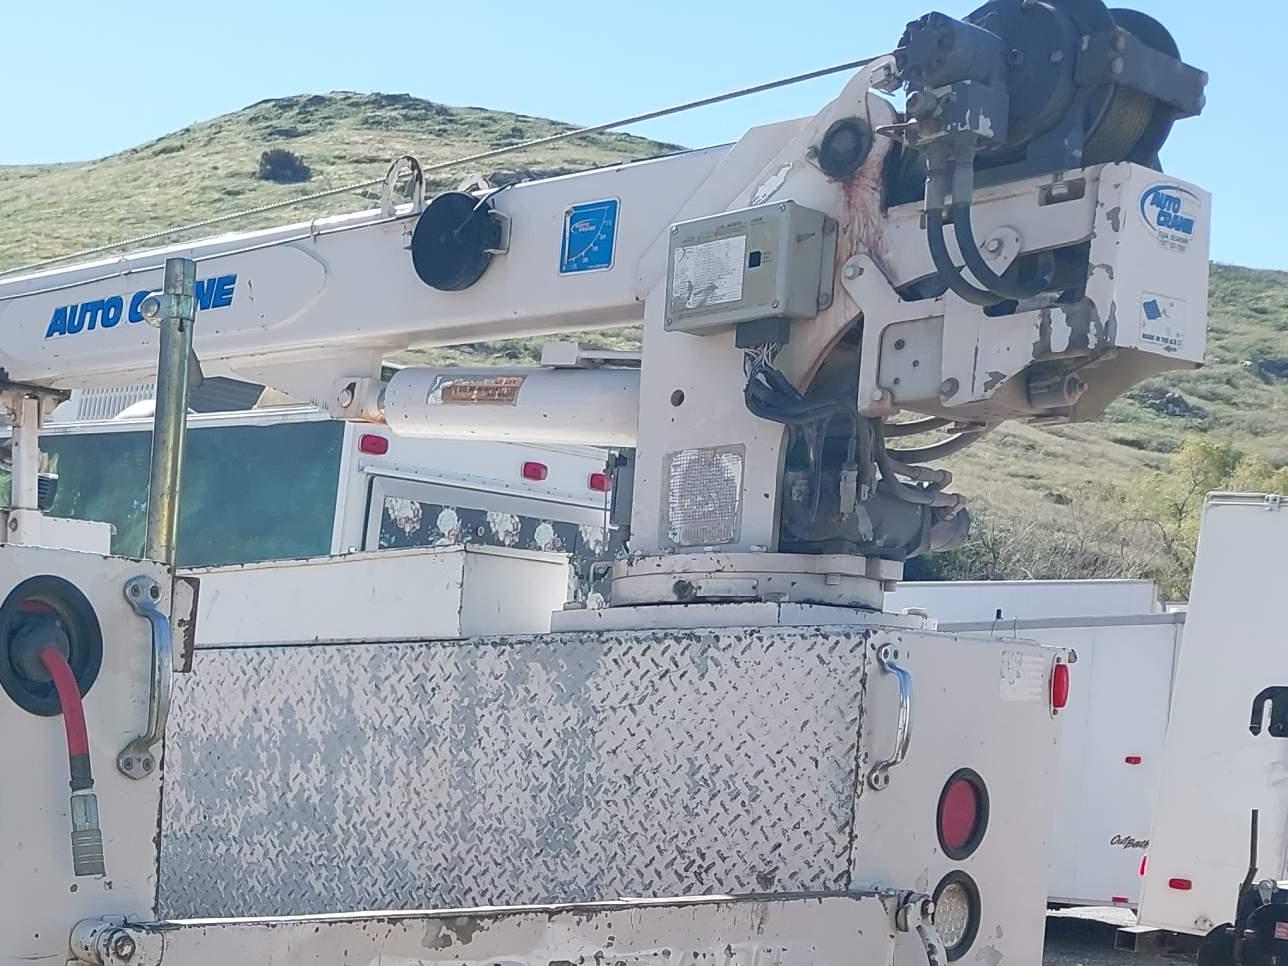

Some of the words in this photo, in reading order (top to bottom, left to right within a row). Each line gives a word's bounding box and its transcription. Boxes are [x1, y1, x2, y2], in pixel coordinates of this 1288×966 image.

[1150, 191, 1181, 213] AUTO
[46, 295, 123, 338] AUTO
[128, 273, 238, 323] CNE
